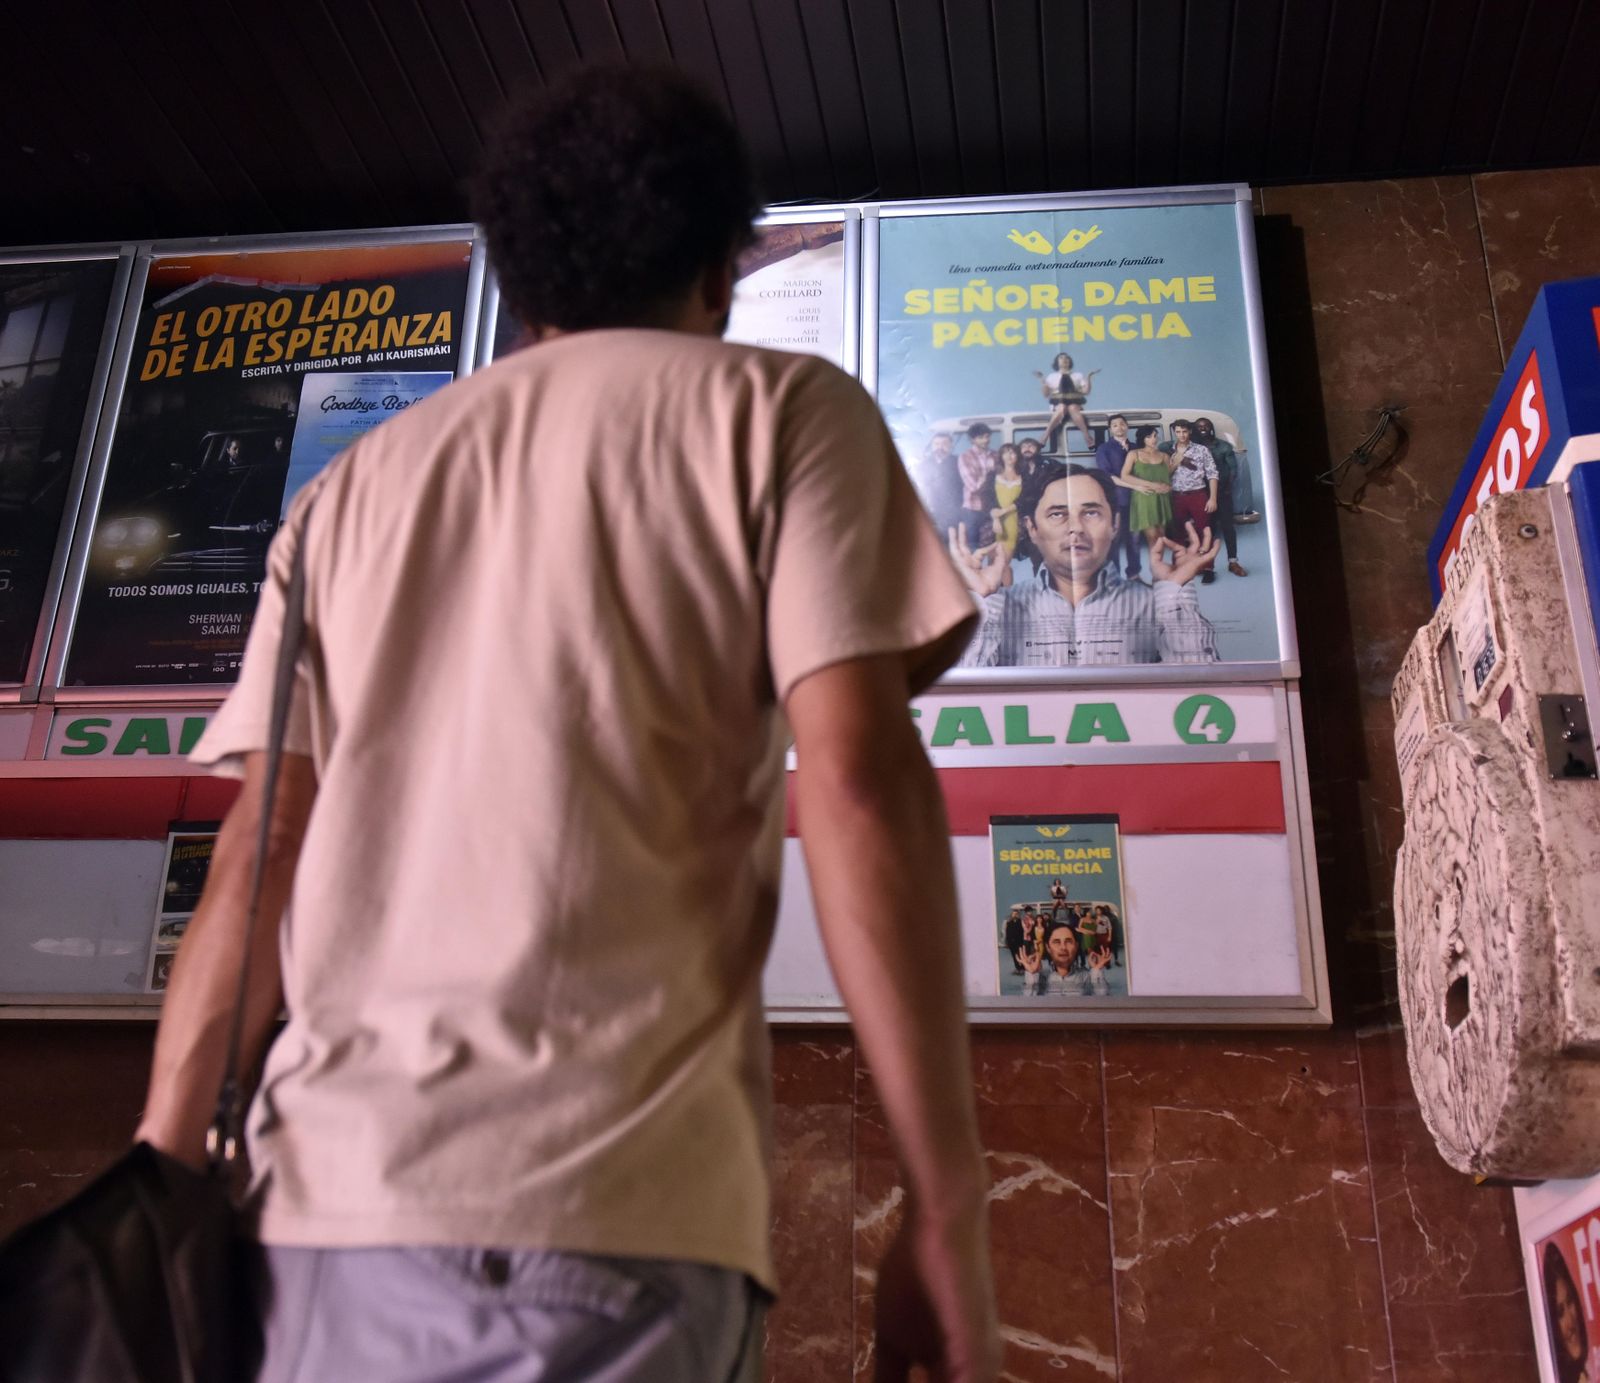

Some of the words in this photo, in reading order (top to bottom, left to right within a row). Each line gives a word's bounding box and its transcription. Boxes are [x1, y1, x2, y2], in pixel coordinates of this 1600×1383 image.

[975, 262, 1022, 273] comedia
[1025, 258, 1117, 271] extremadamente
[1118, 256, 1165, 268] familiar
[759, 289, 822, 298] COTILLARD
[903, 279, 1073, 315] SEÑOR,
[1083, 276, 1217, 307] DAME
[149, 310, 188, 346] EL
[196, 298, 294, 337] OTRO
[298, 284, 396, 325] LADO
[932, 312, 1193, 349] PACIENCIA
[140, 343, 188, 381] DE
[192, 337, 234, 373] LA
[243, 310, 451, 365] ESPERANZA
[241, 365, 282, 378] ESCRITA
[284, 363, 291, 373] Y
[294, 358, 339, 371] DIRIGIDA
[341, 354, 362, 366] POR
[366, 351, 385, 363] AKI
[386, 345, 451, 360] KAURISMÄKI
[320, 395, 379, 414] Goodbye
[108, 585, 147, 598] TODOS
[150, 584, 194, 596] SOMOS
[196, 582, 249, 595] IGUALES,
[189, 613, 242, 624] SHERWAN
[201, 625, 240, 635] SAKARI
[910, 702, 1130, 746] ALA
[1187, 703, 1222, 742] 4
[1000, 847, 1060, 862] SEÑOR,
[1064, 847, 1112, 860] DAME
[1010, 862, 1103, 875] PACIENCIA
